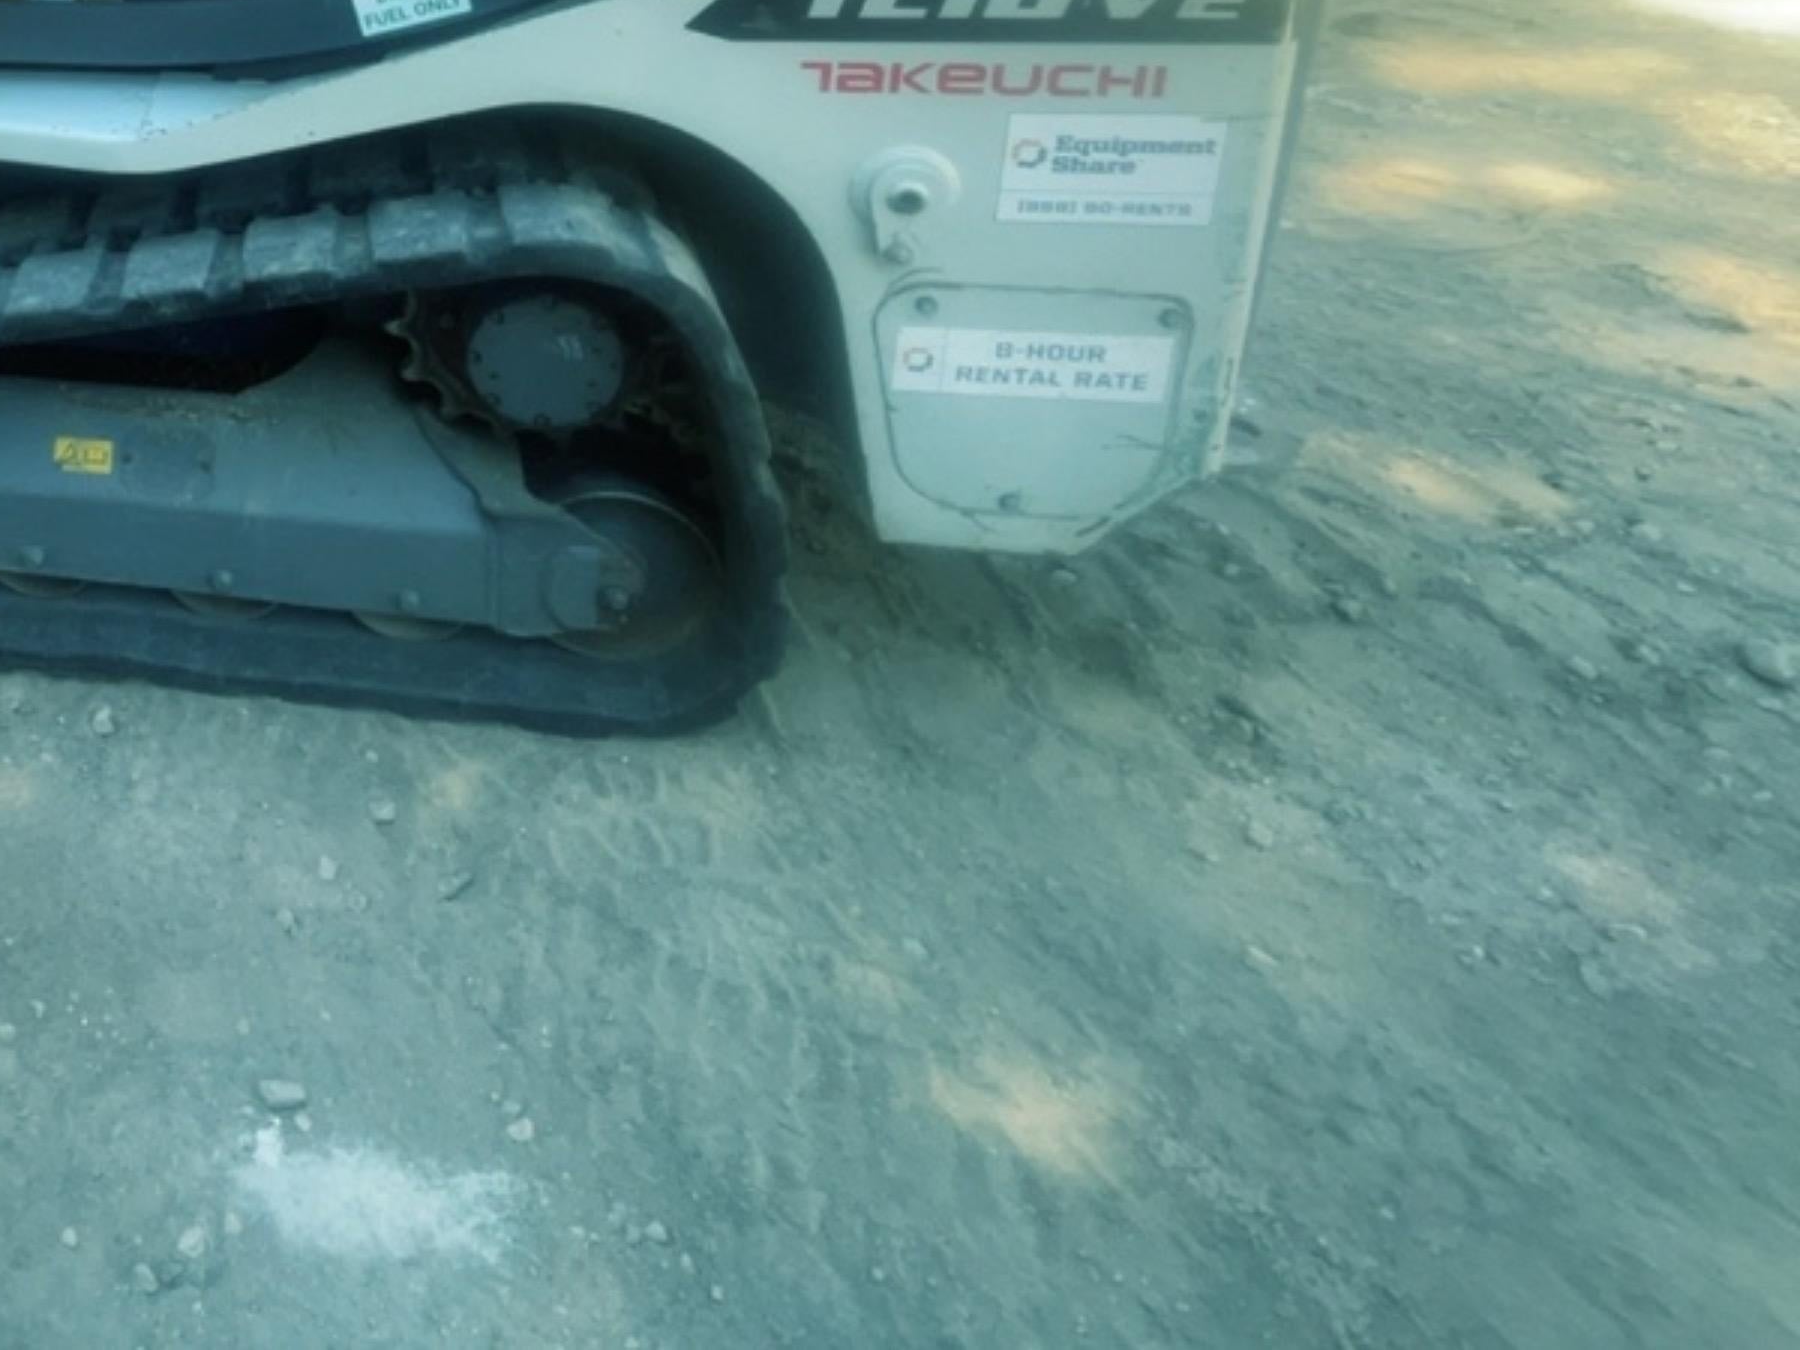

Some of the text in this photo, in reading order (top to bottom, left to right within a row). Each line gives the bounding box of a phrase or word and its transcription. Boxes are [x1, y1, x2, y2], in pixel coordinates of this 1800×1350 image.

[364, 6, 408, 29] FUEL
[1055, 134, 1216, 157] Equipment
[1051, 155, 1137, 175] Share
[955, 364, 1148, 392] RENTAL RATE
